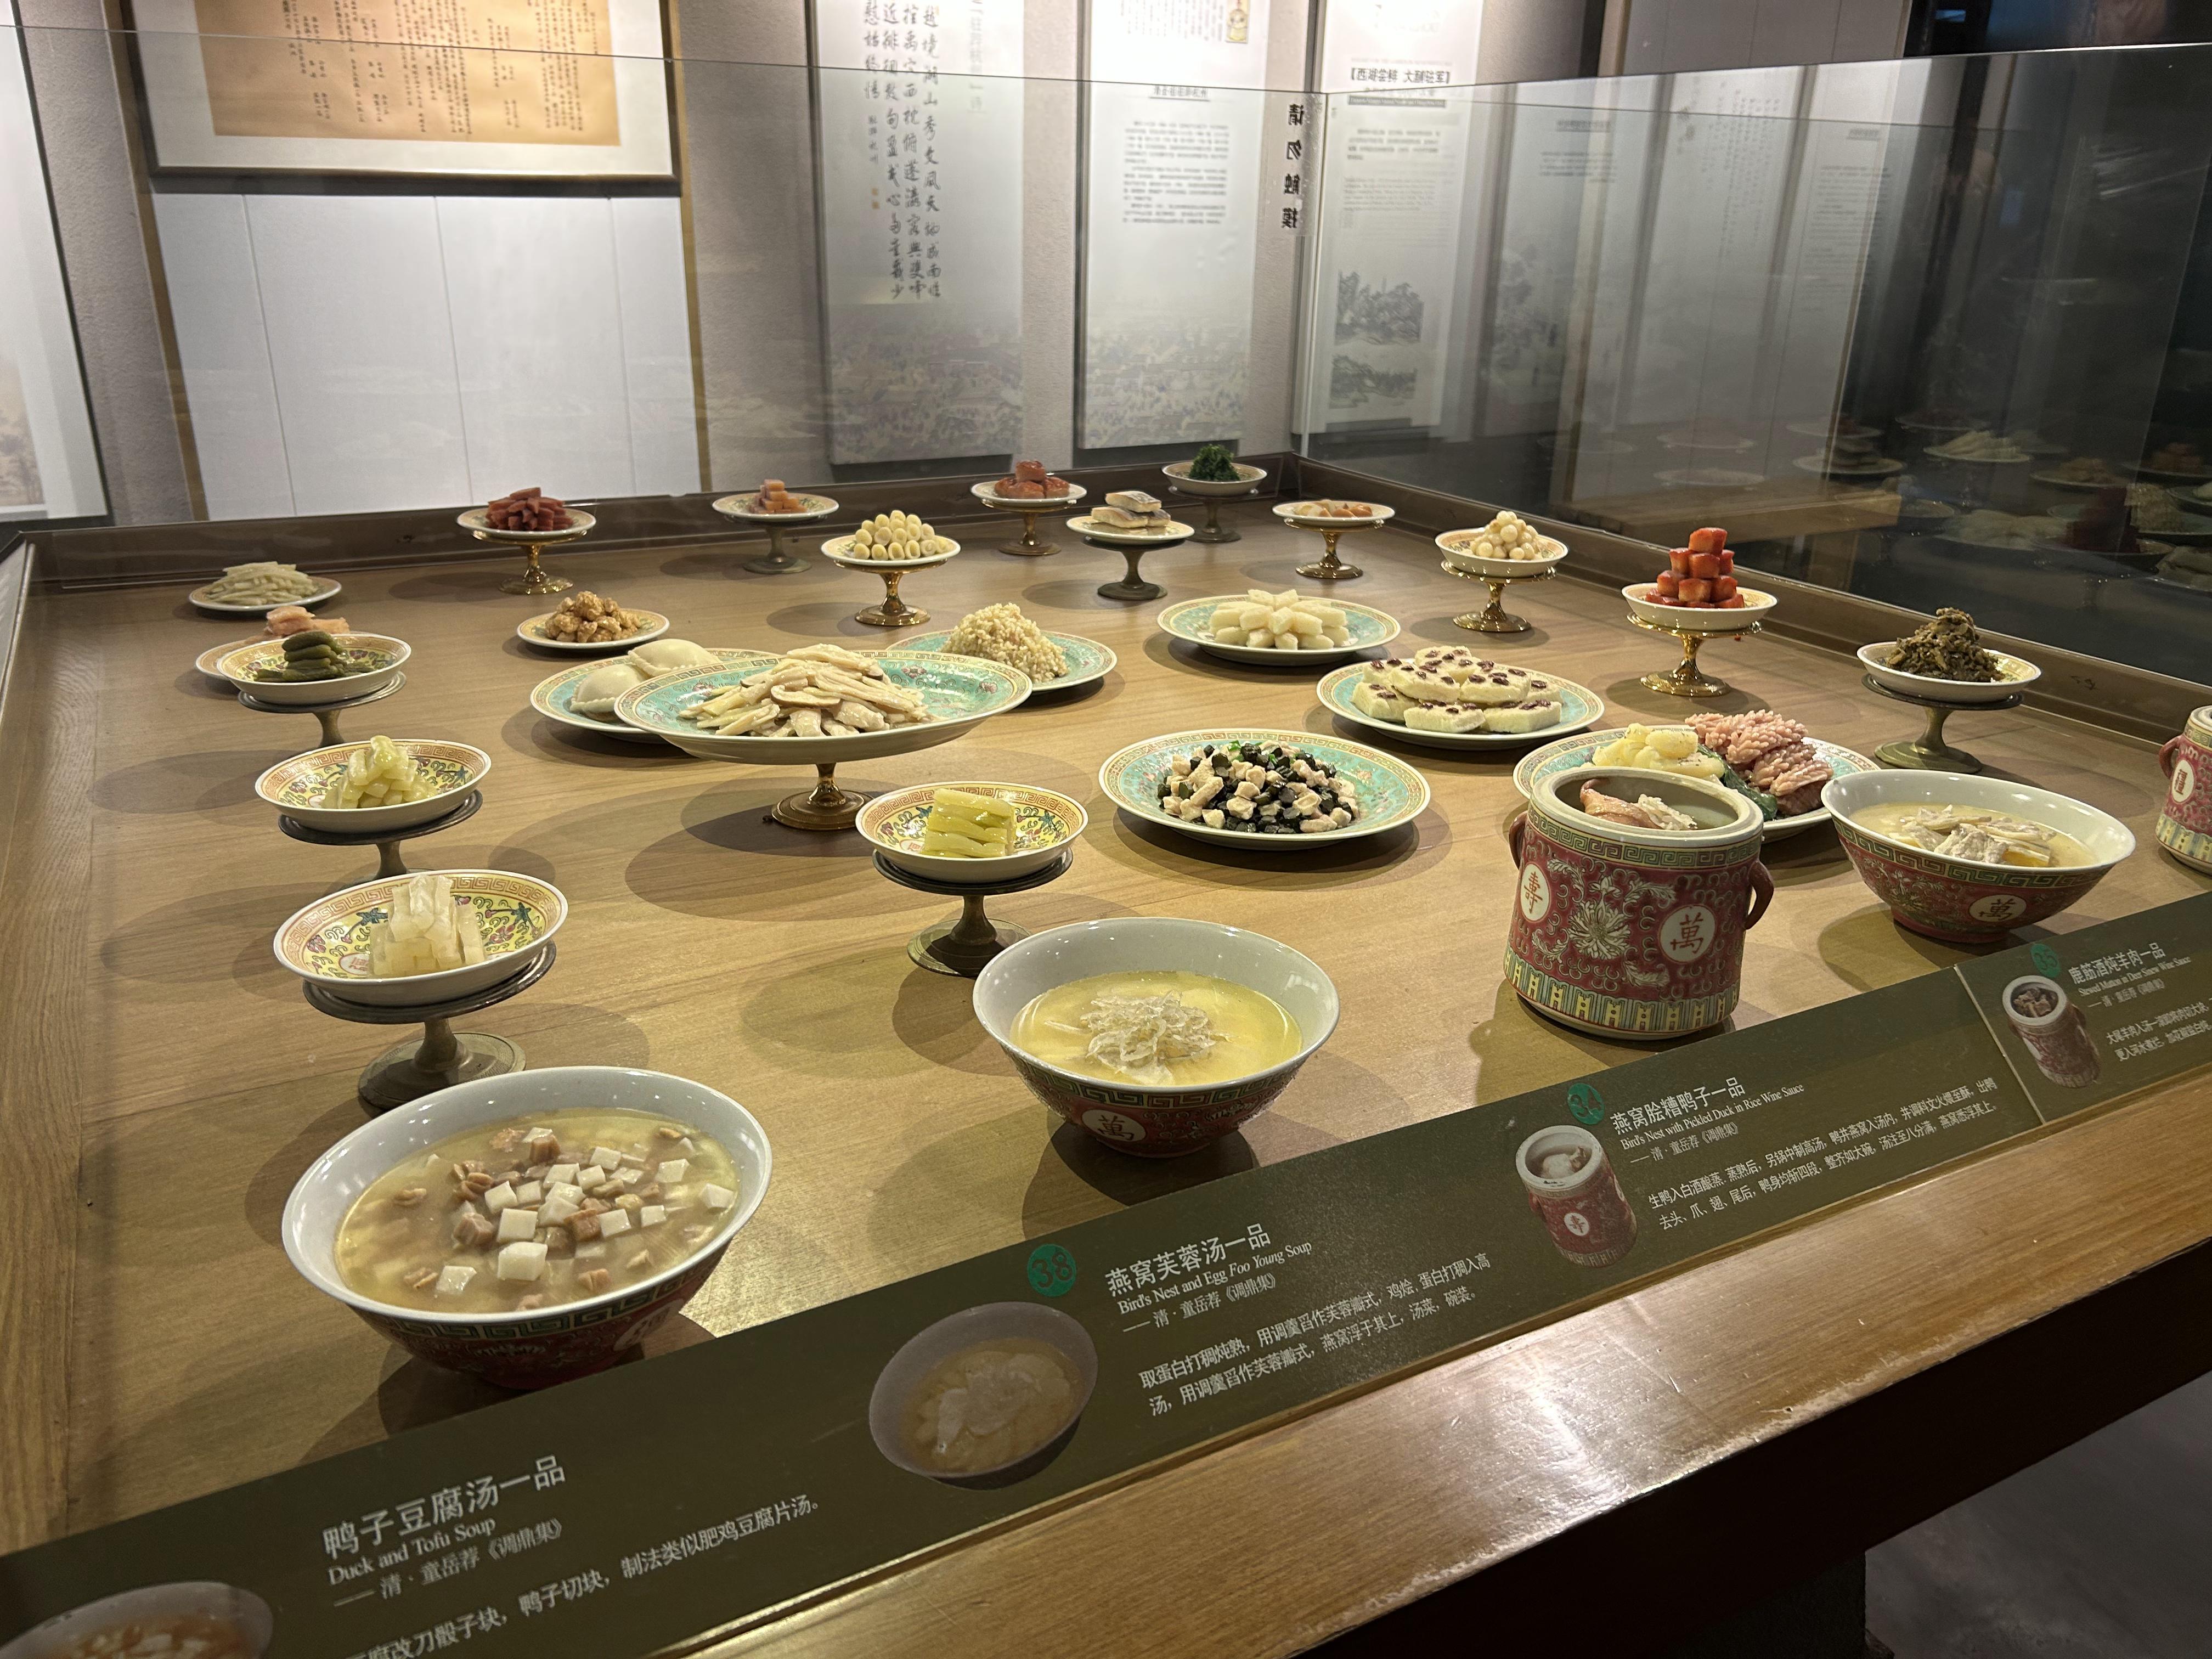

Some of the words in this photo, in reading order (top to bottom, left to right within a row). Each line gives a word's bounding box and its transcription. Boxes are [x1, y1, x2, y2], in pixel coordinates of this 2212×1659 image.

[1610, 1077, 1746, 1135] 燕窝脍糟鸭子一品
[1620, 1135, 1645, 1150] Bird's
[1646, 1129, 1665, 1143] Nest
[1664, 1122, 1684, 1137] with
[1684, 1114, 1713, 1133] Pickled
[1713, 1107, 1735, 1121] Duck
[1736, 1102, 1745, 1113] in
[1743, 1097, 1762, 1111] Rice
[1761, 1091, 1782, 1104] Wine
[1782, 1084, 1805, 1098] Sauce
[1031, 1250, 1074, 1289] 38
[1105, 1223, 1271, 1297] 燕窝芙蓉汤一品
[1117, 1293, 1152, 1314] Bird's
[1152, 1286, 1181, 1304] Nest
[1182, 1276, 1203, 1293] and
[1204, 1269, 1229, 1289] Egg
[1229, 1261, 1251, 1277] Foo
[1251, 1250, 1285, 1272] Young
[1285, 1240, 1313, 1259] Soup
[322, 1454, 566, 1560] 鸭子豆腐汤一品
[328, 1557, 375, 1585] Duck
[379, 1543, 410, 1568] and
[411, 1531, 451, 1556] Tofu
[455, 1517, 496, 1542] Soup
[346, 1494, 819, 1659] 腐改刀骰子块，鸭子切块，制法类似肥鸡豆腐片汤。
